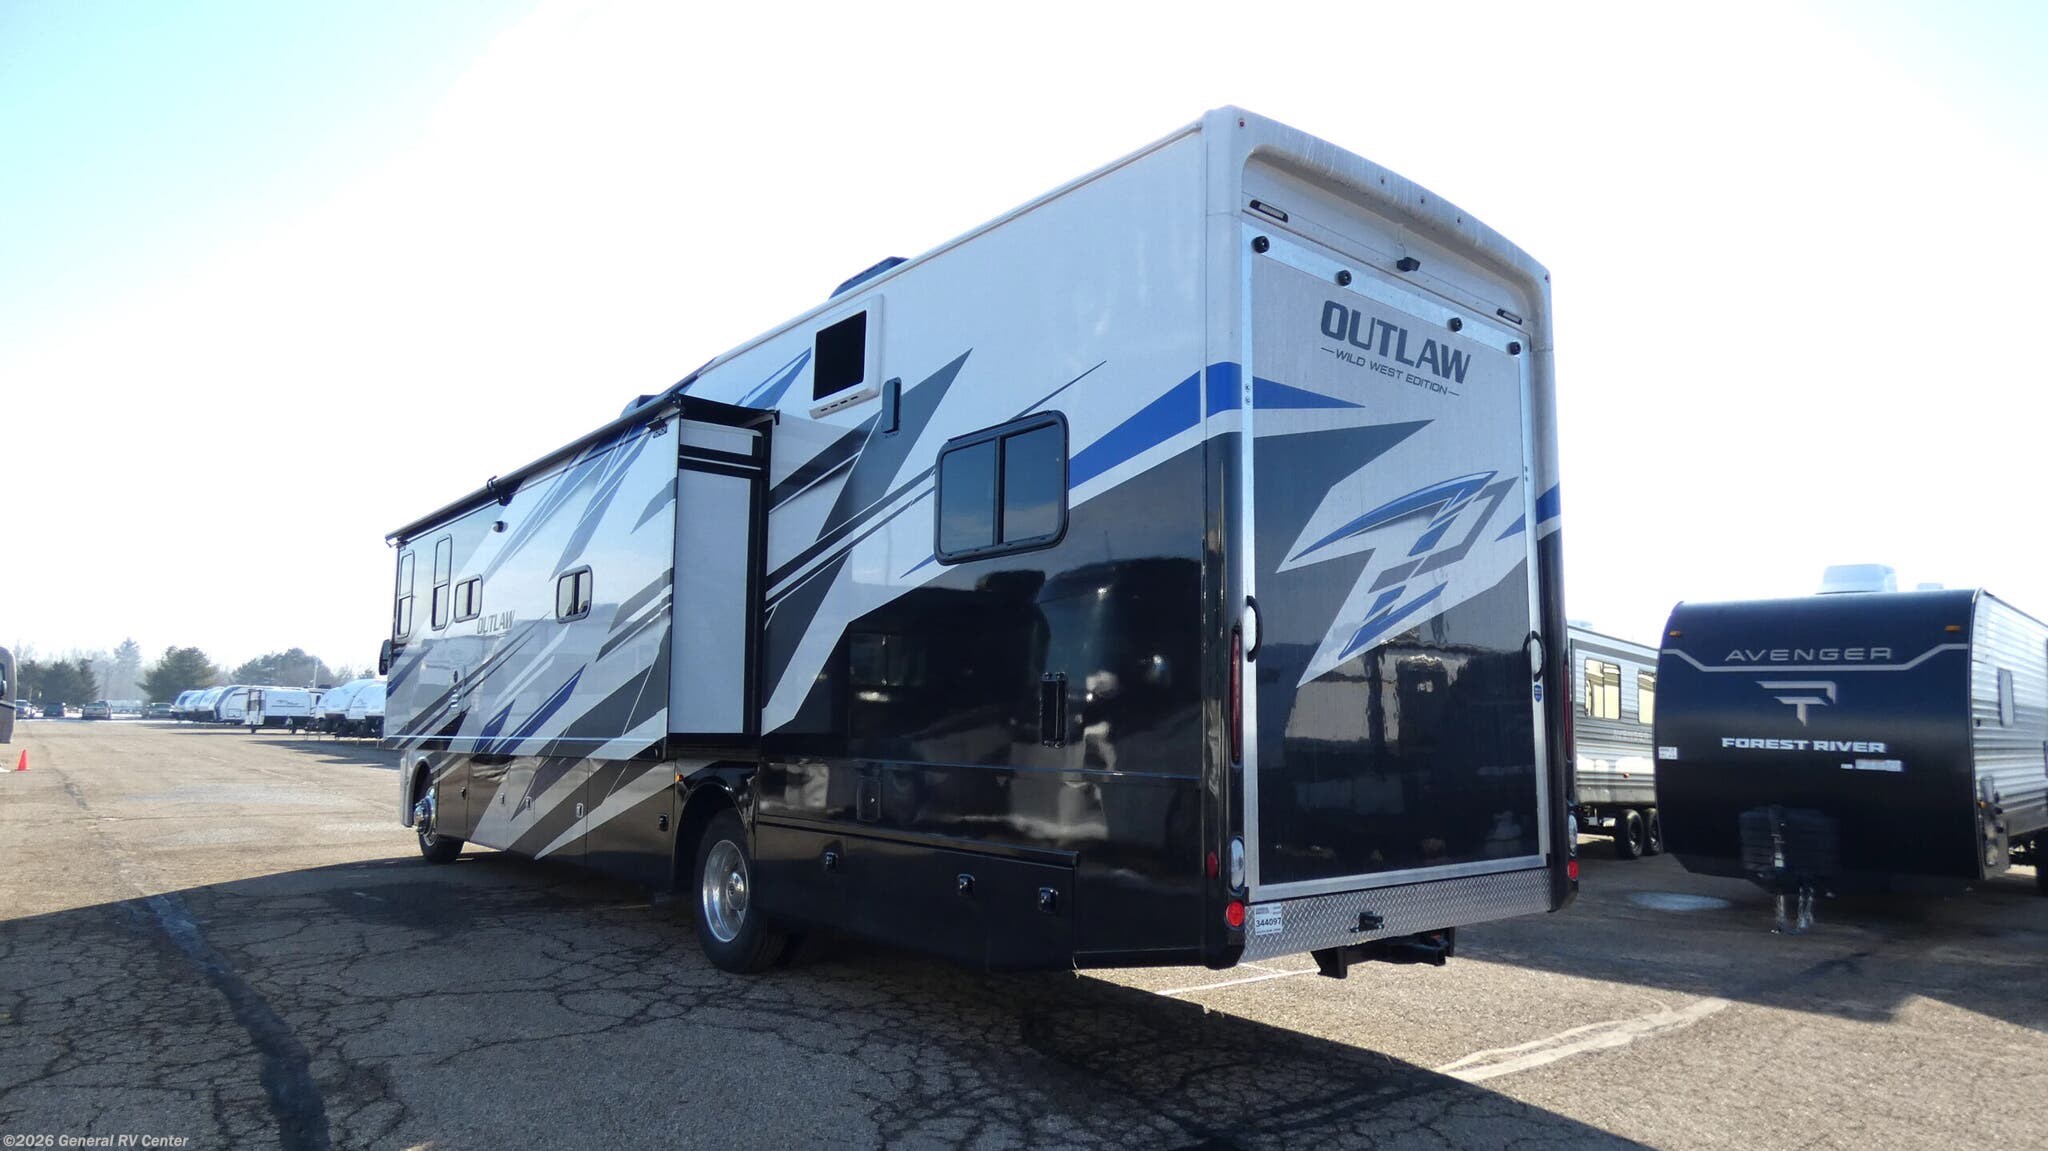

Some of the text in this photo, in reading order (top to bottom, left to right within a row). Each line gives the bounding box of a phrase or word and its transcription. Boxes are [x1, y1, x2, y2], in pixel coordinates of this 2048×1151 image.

[1321, 300, 1471, 384] OUTLAW
[1335, 348, 1448, 395] WILD WEST EDITION
[477, 609, 515, 635] OUTLAW
[1724, 647, 1892, 661] AVENGER
[1721, 737, 1887, 753] FOREST RIVER
[1255, 917, 1282, 928] 344097
